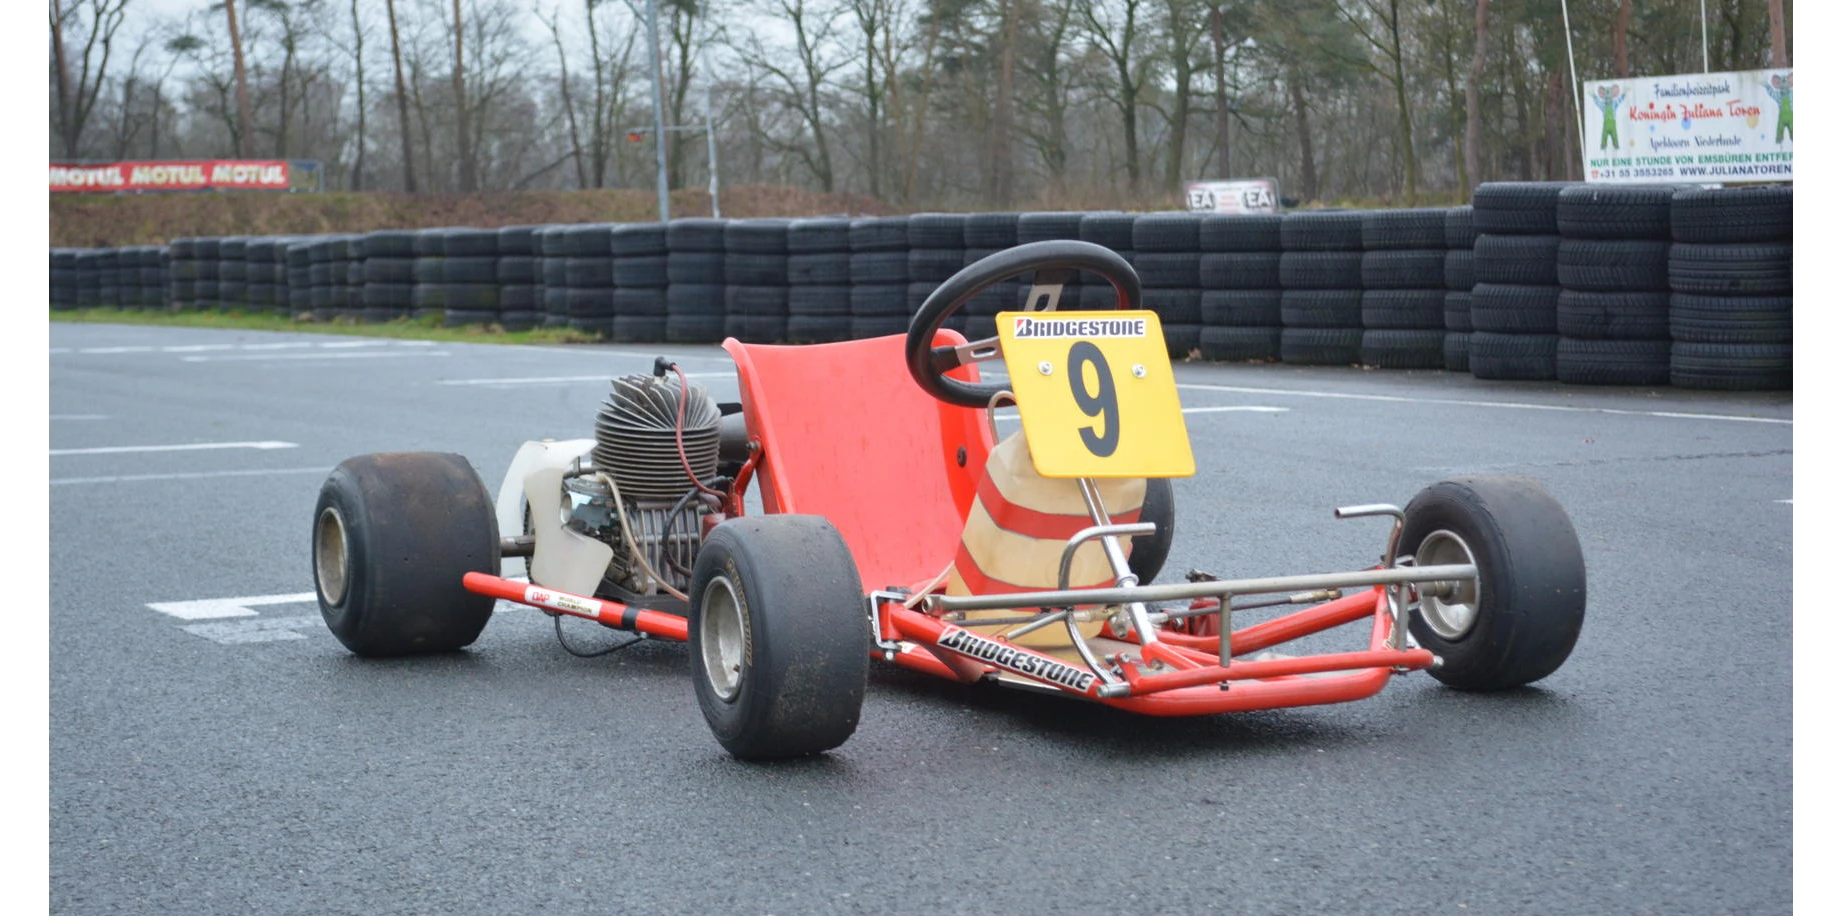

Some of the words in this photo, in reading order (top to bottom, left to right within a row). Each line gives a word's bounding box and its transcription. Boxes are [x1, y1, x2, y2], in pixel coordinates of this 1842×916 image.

[1629, 102, 1677, 121] Koningin
[1680, 103, 1723, 121] Juliana
[1726, 99, 1760, 116] Toren
[1590, 159, 1609, 167] NUR
[1612, 157, 1632, 166] EINE
[1636, 156, 1672, 165] STUNDE
[1674, 155, 1694, 164] VON
[1698, 152, 1752, 163] EMSBÜREN
[48, 167, 124, 186] MOTUL
[130, 165, 206, 184] MOTUL
[211, 163, 286, 183] MOTUL
[1016, 319, 1144, 337] BRIDGESTONE
[1067, 341, 1120, 457] 9
[557, 602, 593, 613] CHAMPION
[938, 631, 1093, 690] BRIDGESTONE
